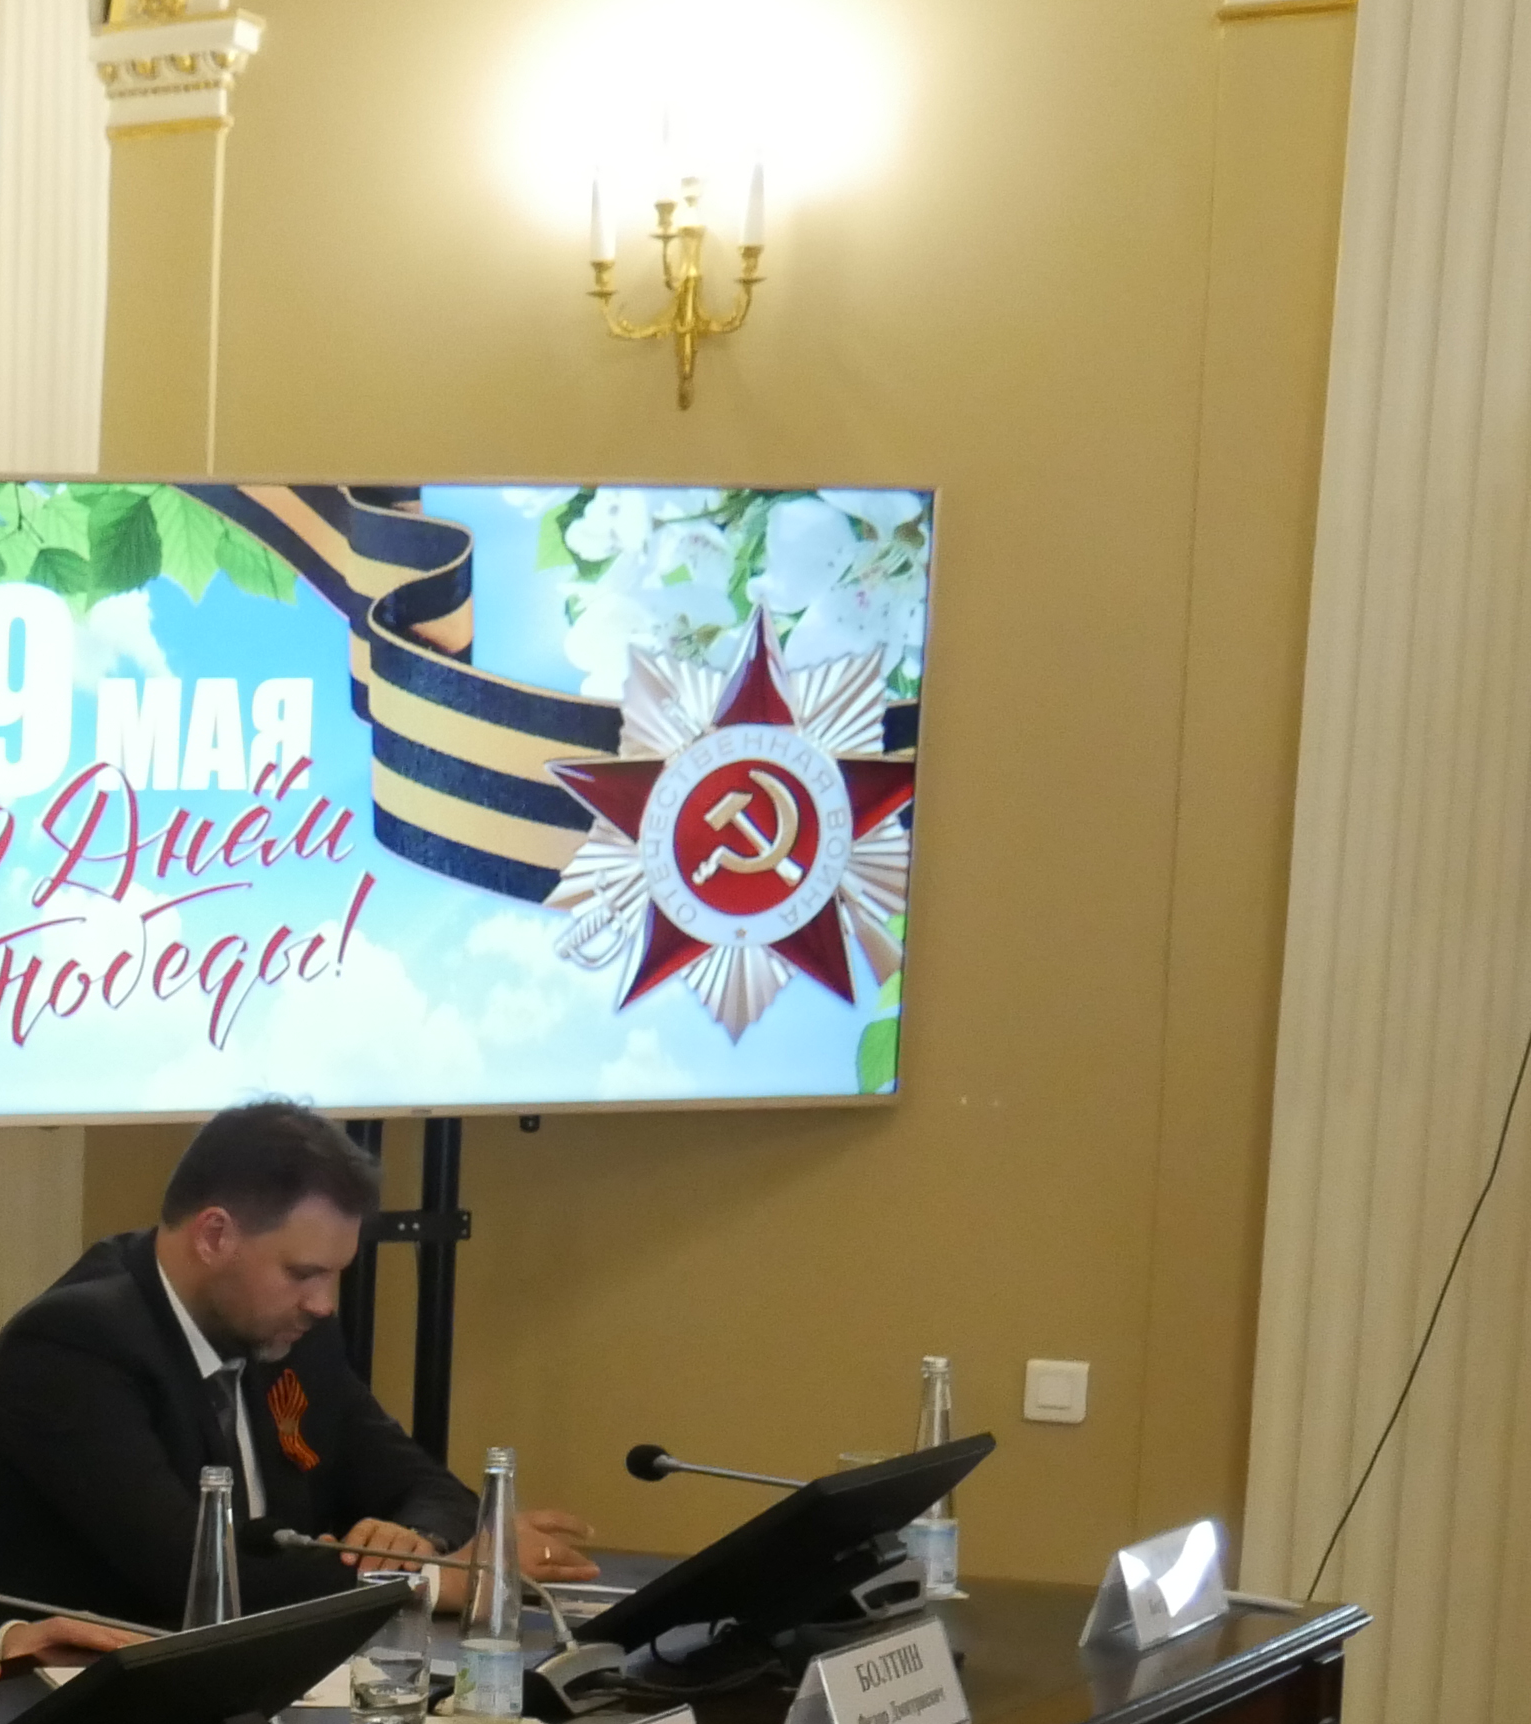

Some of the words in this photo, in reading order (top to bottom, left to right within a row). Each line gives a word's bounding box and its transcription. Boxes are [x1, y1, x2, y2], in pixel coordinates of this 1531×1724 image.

[96, 677, 313, 792] МАЯ
[32, 756, 354, 908] Днём
[854, 1643, 924, 1692] БОЛТИН
